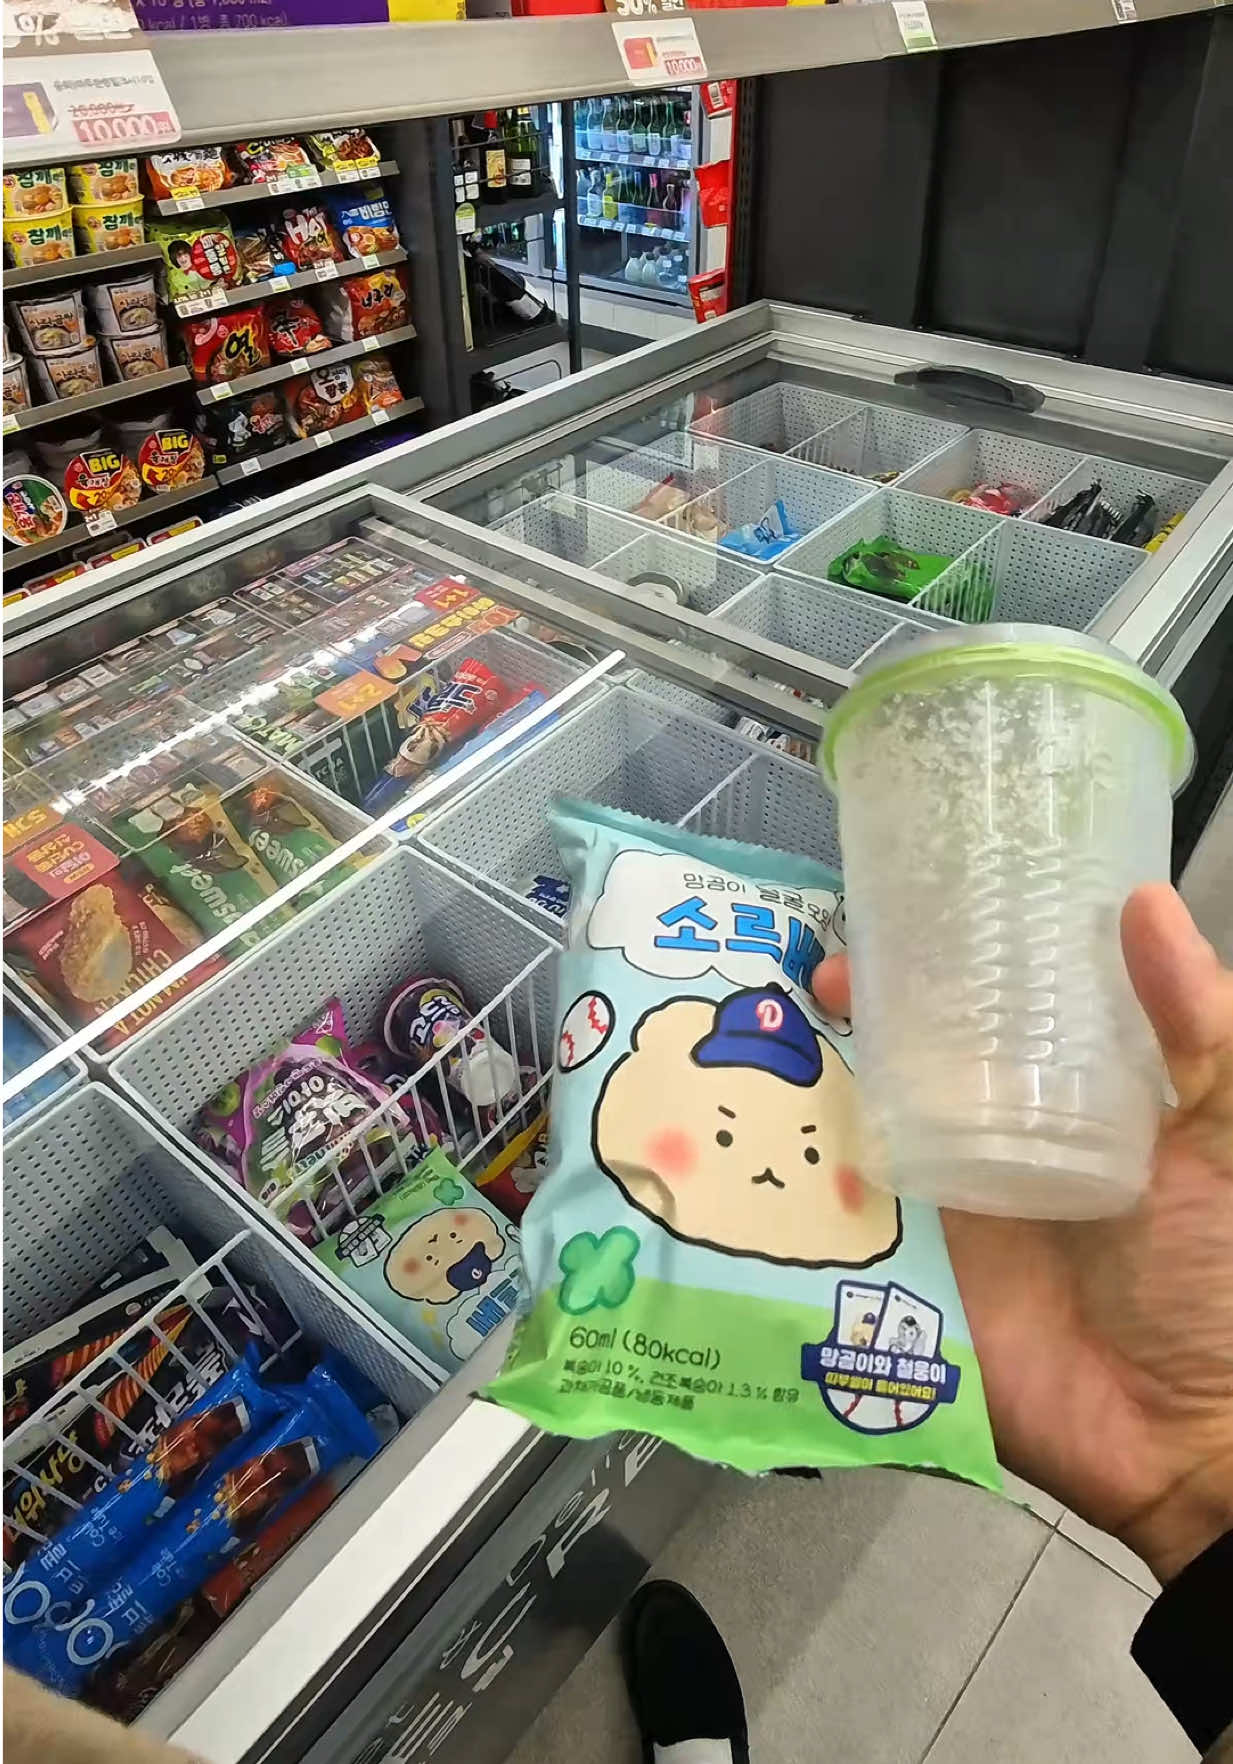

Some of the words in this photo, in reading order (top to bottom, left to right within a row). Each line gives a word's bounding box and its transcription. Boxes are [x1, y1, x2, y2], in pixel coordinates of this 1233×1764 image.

[161, 434, 189, 451] BIG
[88, 454, 120, 473] BIG
[568, 1324, 616, 1350] 60ml
[621, 1328, 722, 1370] (80kcal)
[818, 1345, 894, 1376] 망곰이와
[604, 1360, 623, 1377] 10
[727, 1380, 752, 1399] 1.3
